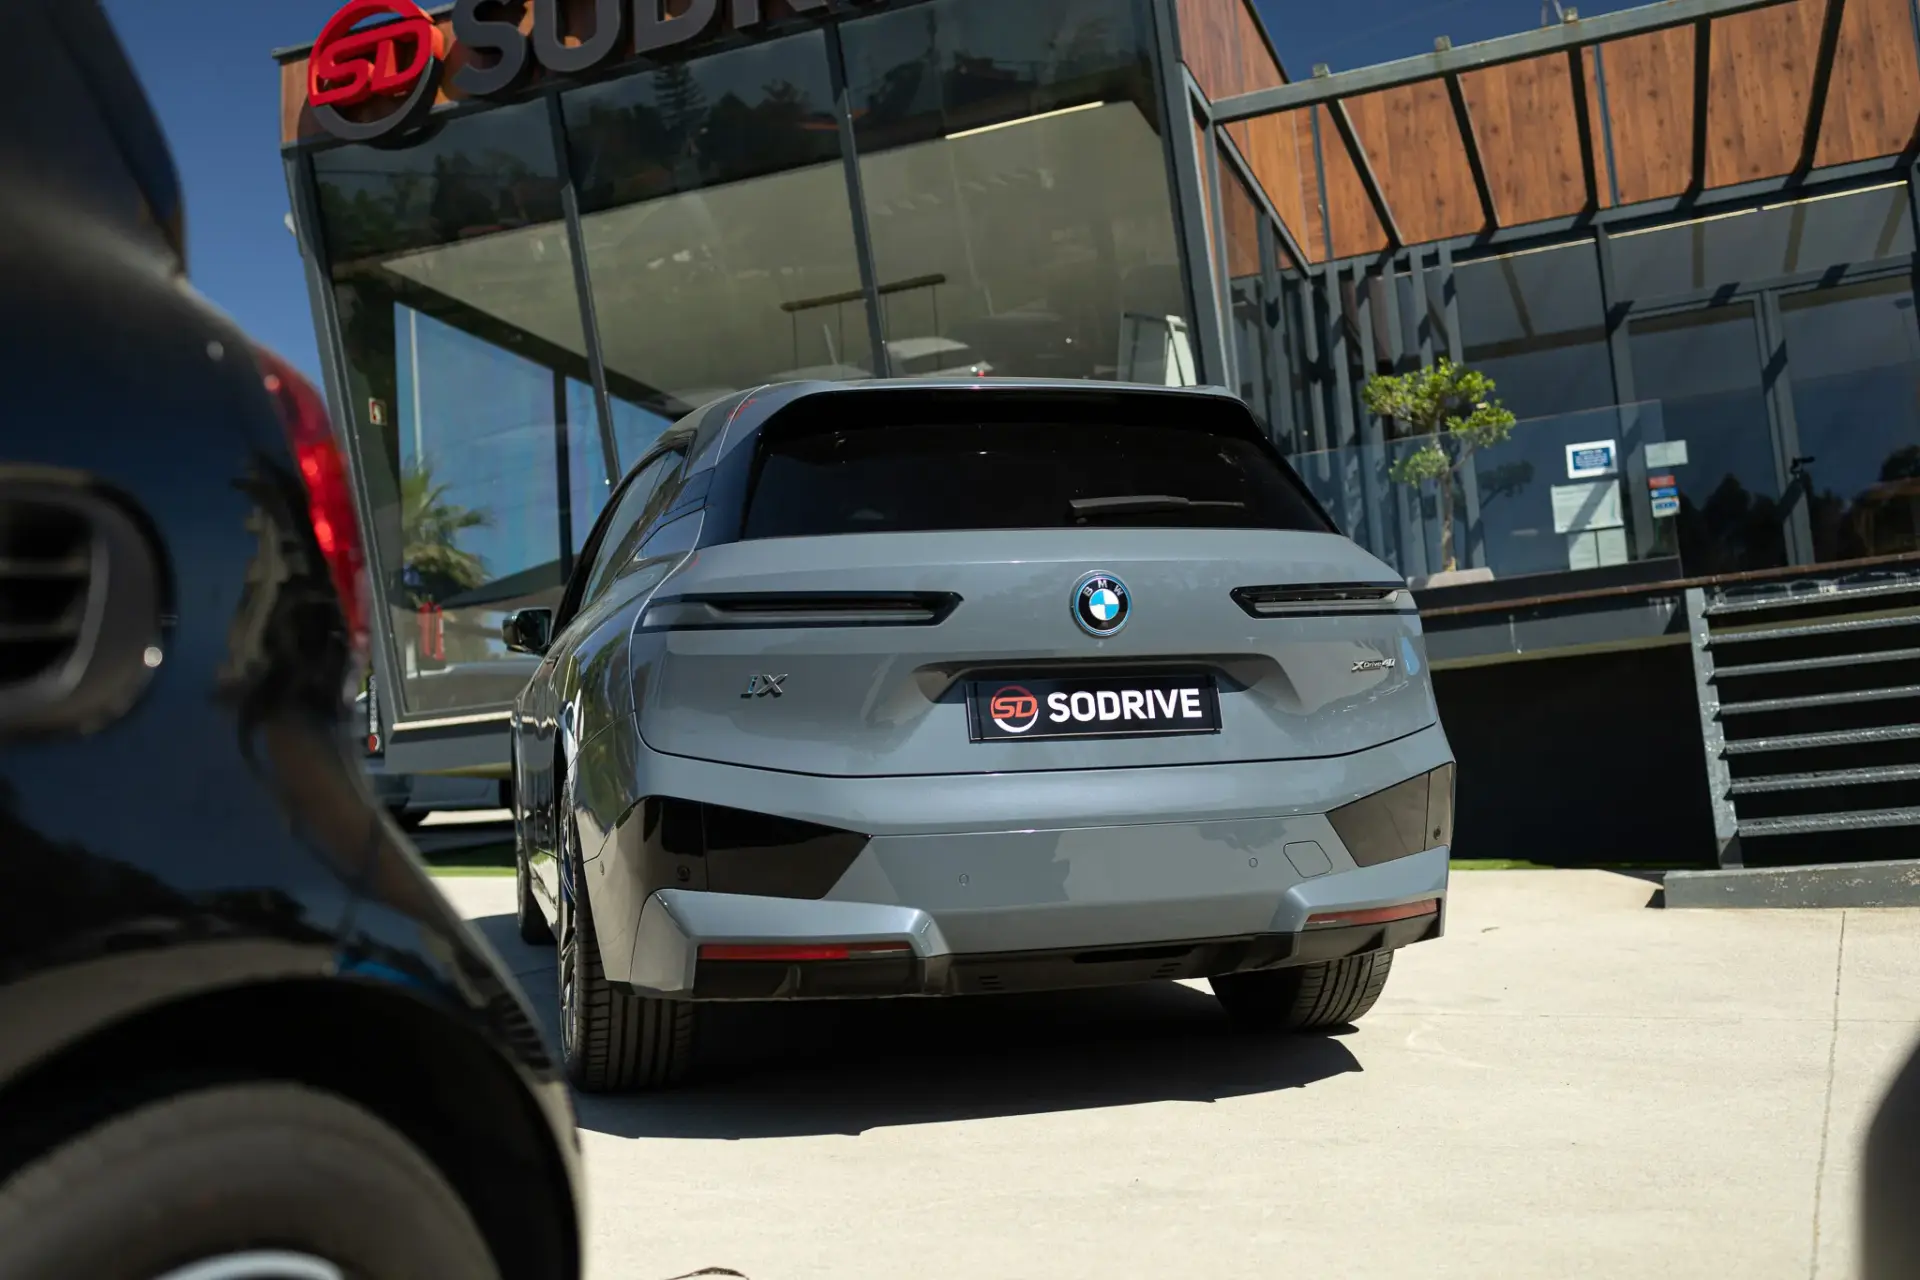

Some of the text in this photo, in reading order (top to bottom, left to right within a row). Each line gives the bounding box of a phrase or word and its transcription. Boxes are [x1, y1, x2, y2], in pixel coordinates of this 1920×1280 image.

[1082, 579, 1124, 597] BMW
[992, 688, 1203, 723] SD SODRIVE
